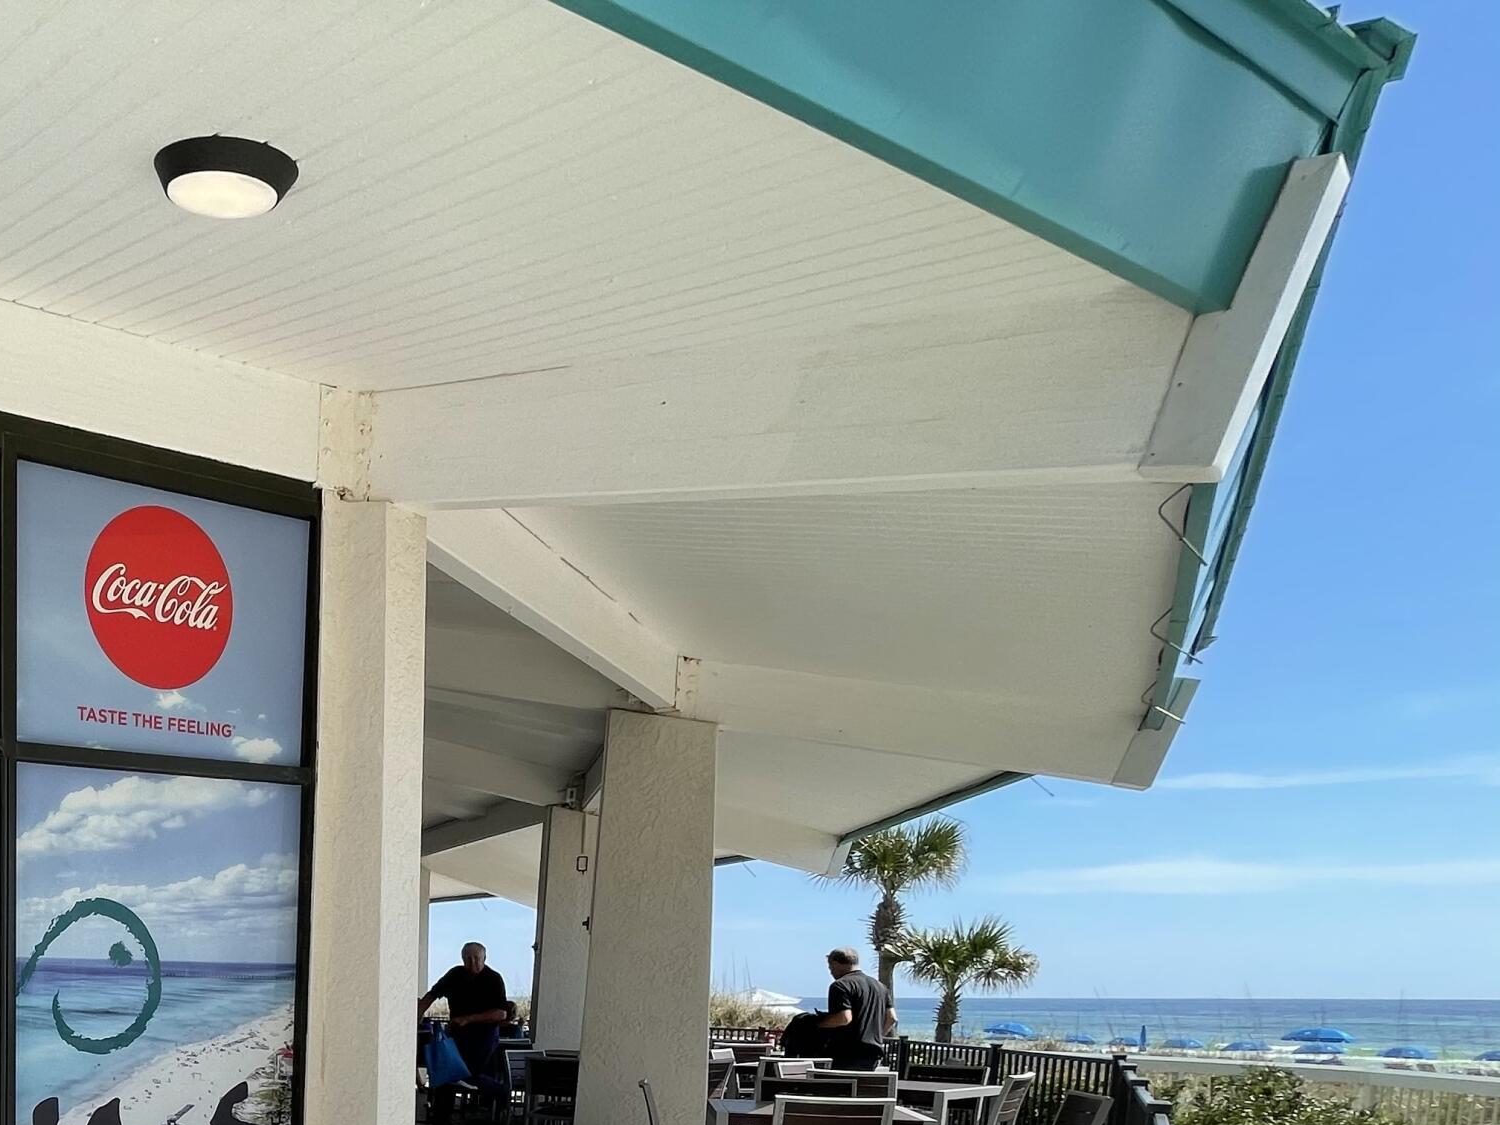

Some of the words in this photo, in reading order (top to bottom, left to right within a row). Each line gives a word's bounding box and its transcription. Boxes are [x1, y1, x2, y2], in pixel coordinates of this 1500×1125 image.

[92, 563, 227, 630] Coca-Cola
[77, 706, 127, 725] TASTE
[132, 713, 163, 730] THE
[168, 717, 233, 738] FEELING
